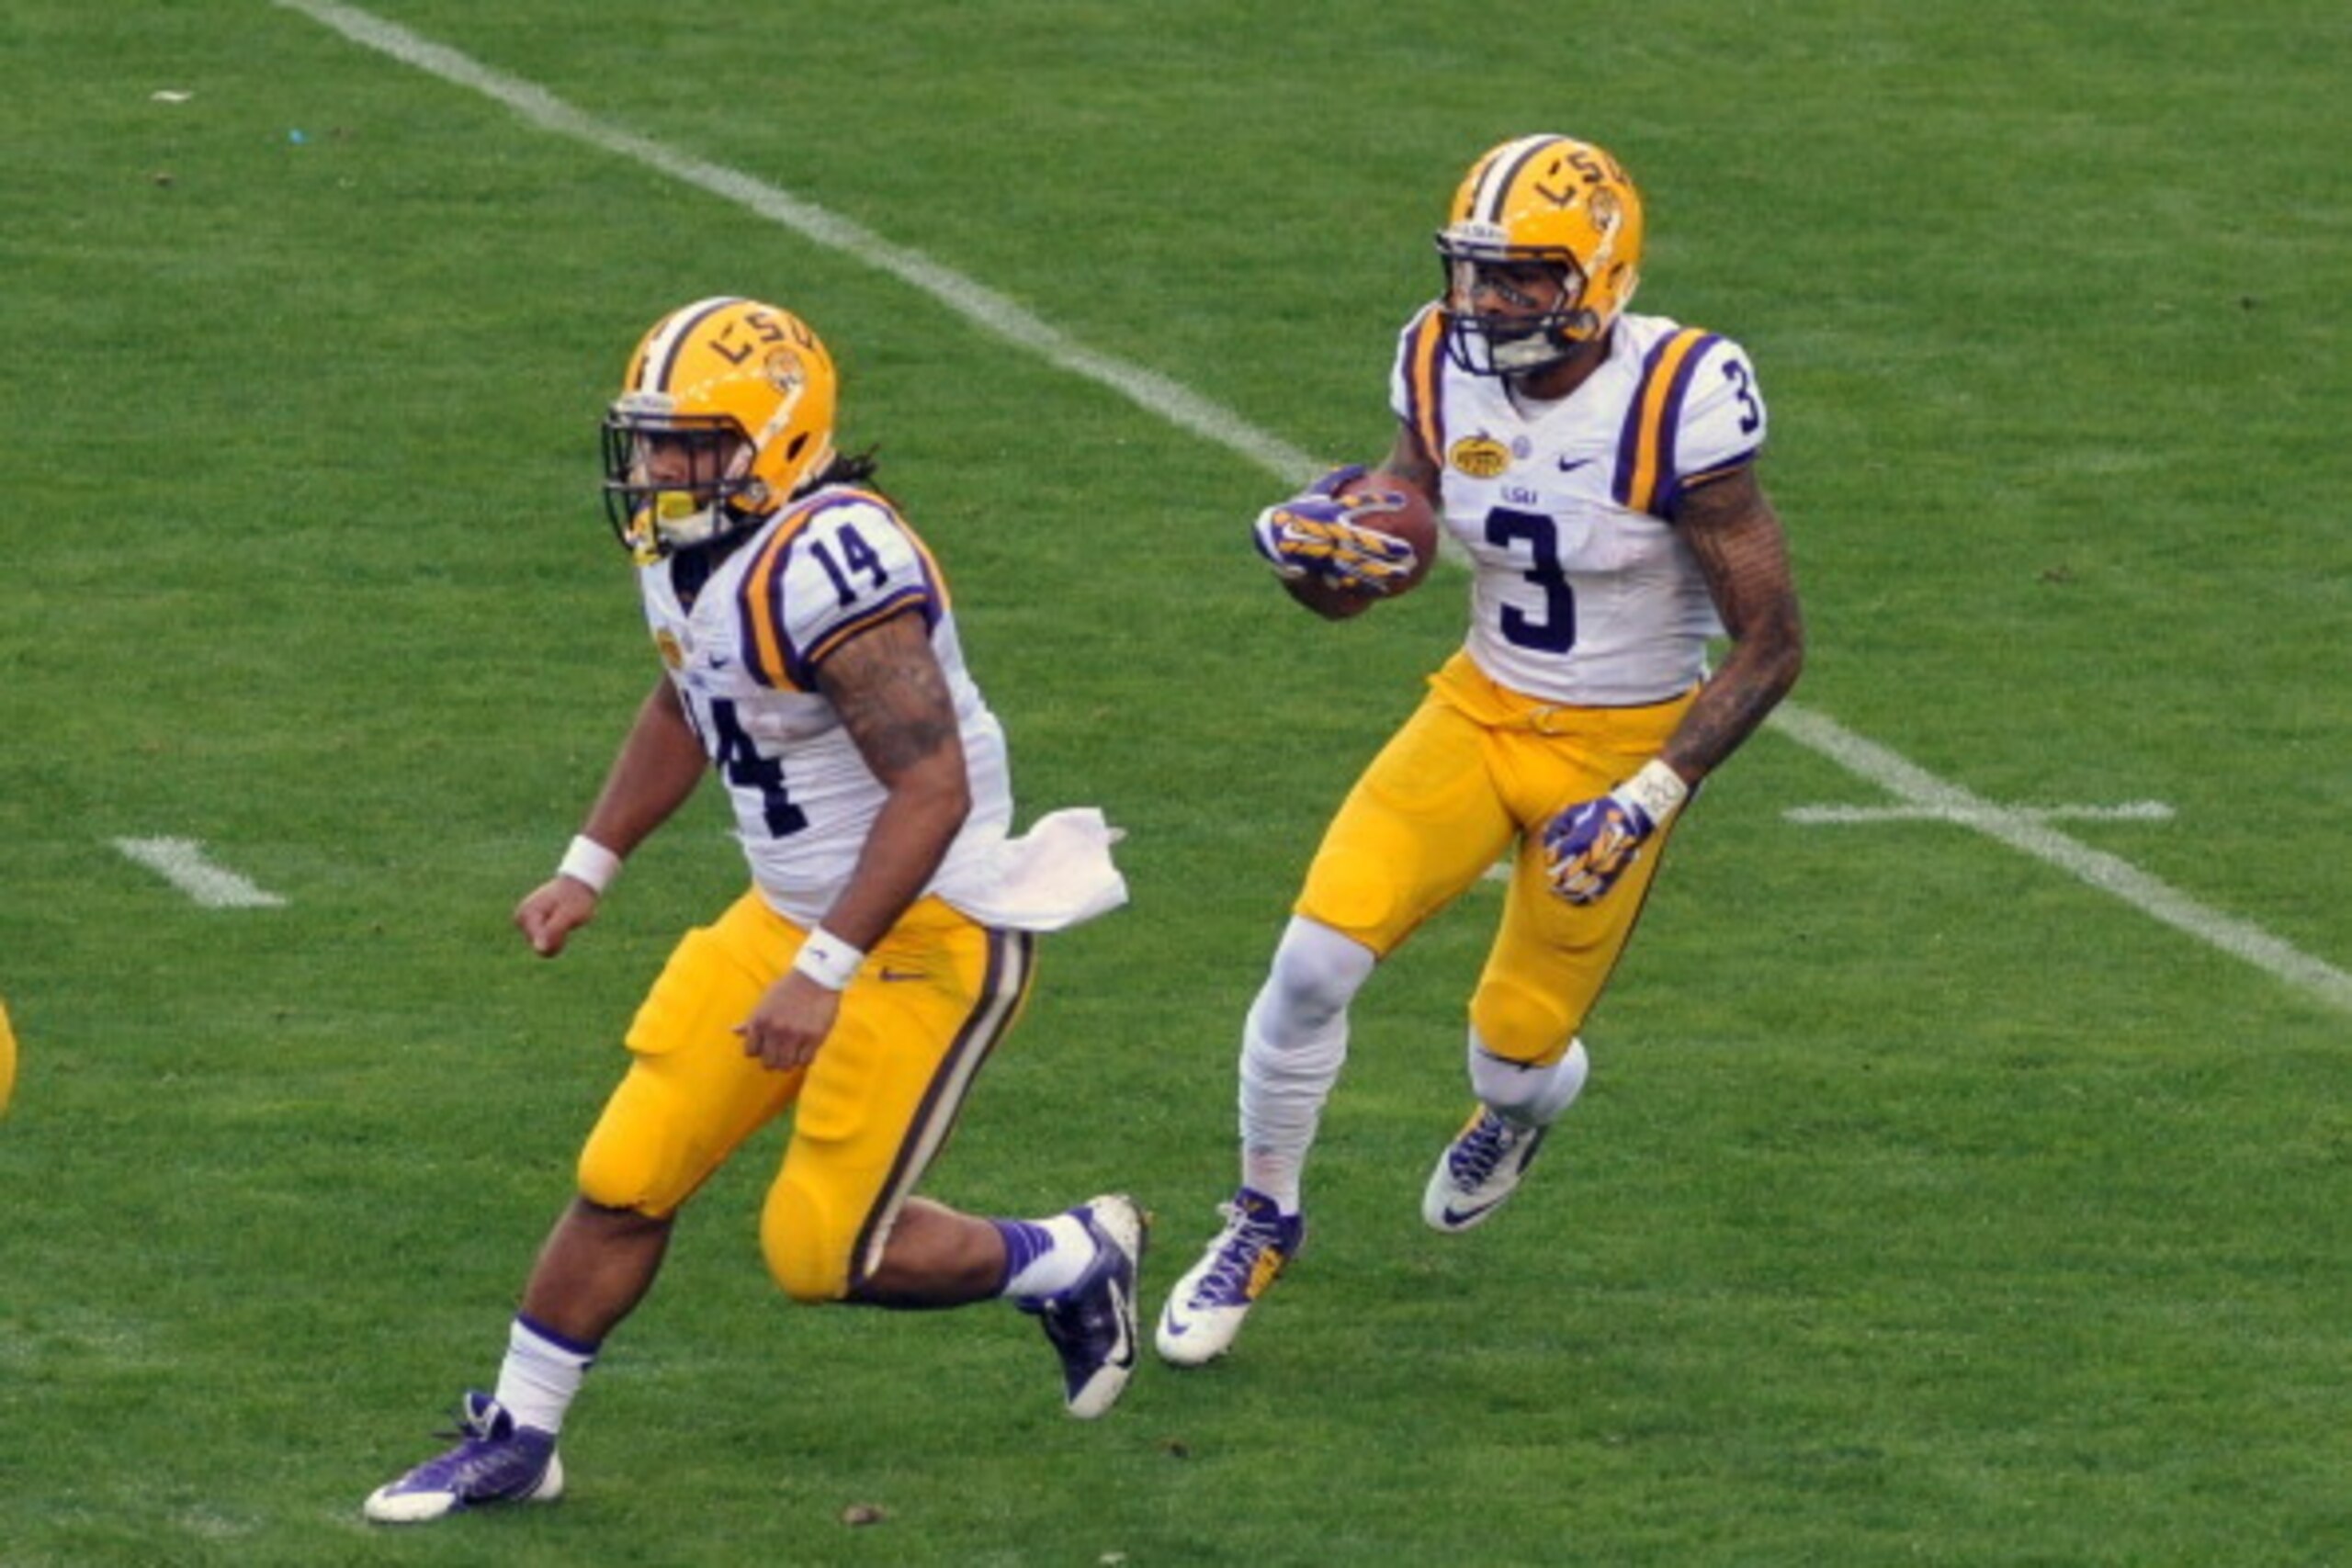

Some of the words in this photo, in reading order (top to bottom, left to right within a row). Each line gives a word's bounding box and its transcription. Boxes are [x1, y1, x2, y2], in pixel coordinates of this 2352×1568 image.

[1721, 359, 1760, 434] 3
[808, 523, 888, 606] 14
[1485, 505, 1577, 655] 3
